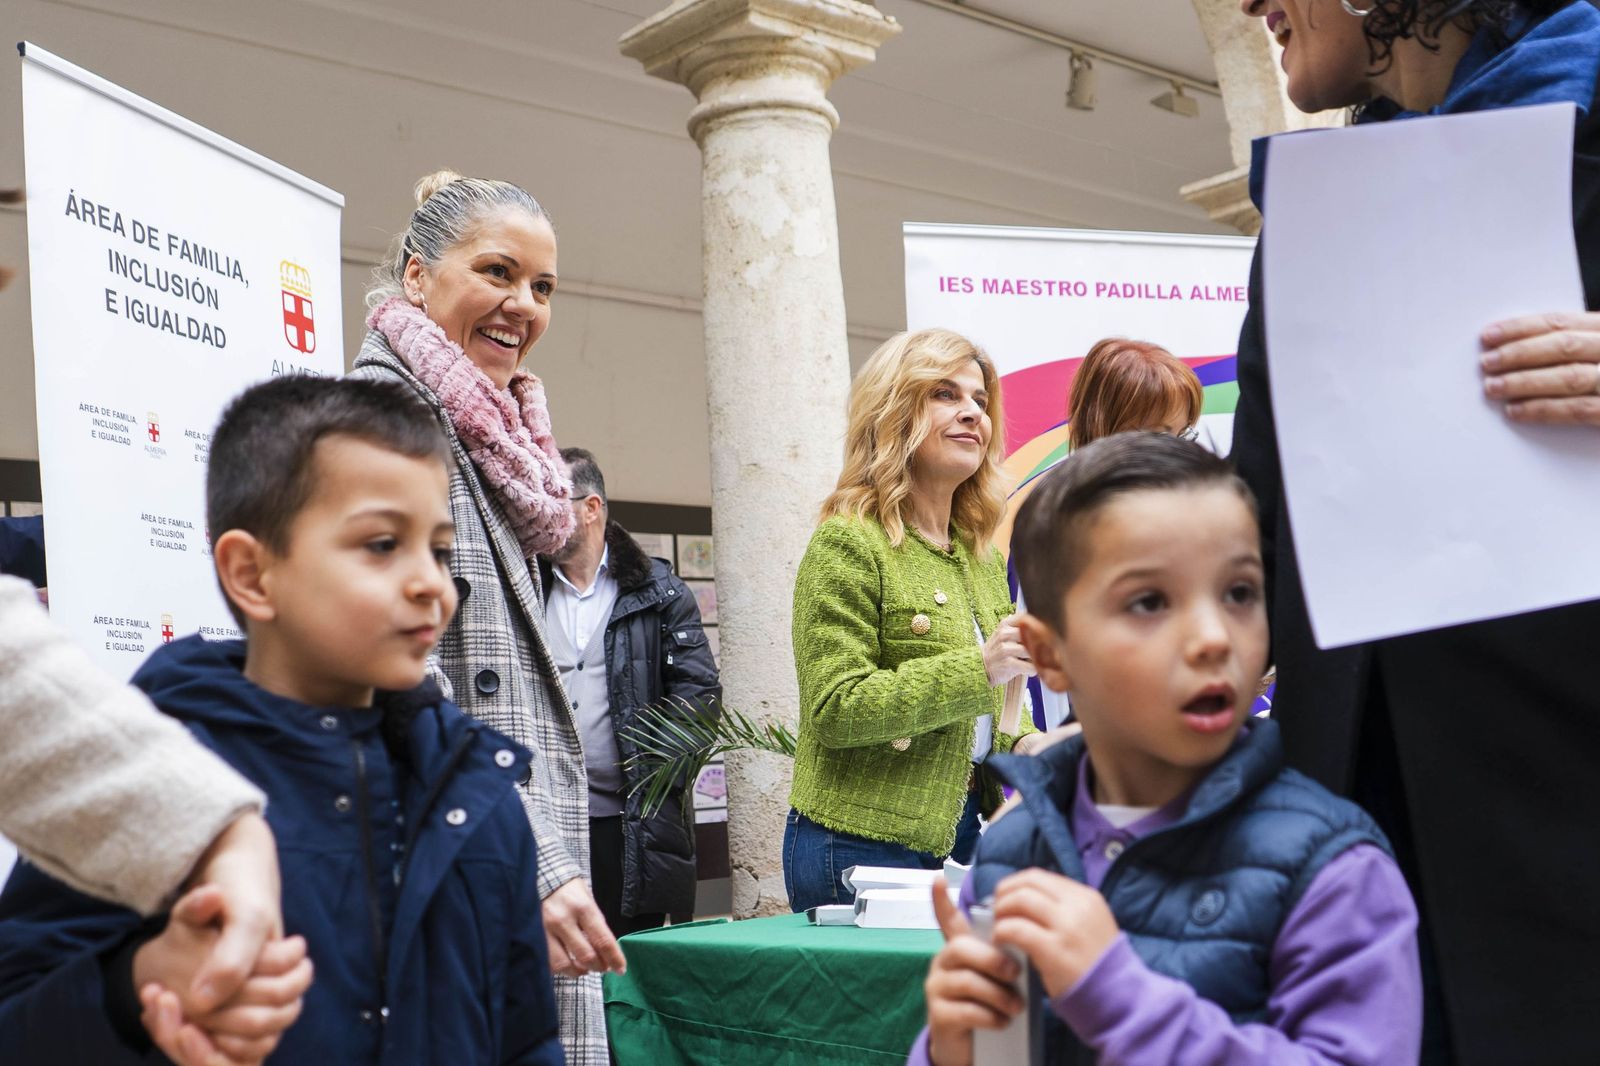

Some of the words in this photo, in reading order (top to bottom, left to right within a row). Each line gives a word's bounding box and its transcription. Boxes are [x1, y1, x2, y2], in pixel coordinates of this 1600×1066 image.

[65, 188, 126, 237] ÁREA
[132, 219, 160, 251] DE
[167, 233, 250, 288] FAMILIA,
[108, 248, 219, 310] INCLUSIÓN
[939, 275, 974, 293] IES
[982, 278, 1088, 297] MAESTRO
[1096, 282, 1182, 300] PADILLA
[1190, 285, 1249, 301] ALME
[105, 288, 119, 314] E
[125, 295, 227, 349] IGUALDAD
[101, 407, 111, 417] DE
[91, 430, 97, 438] E
[98, 431, 131, 446] IGUALDAD
[158, 516, 167, 525] DE
[150, 538, 155, 547] E
[156, 539, 187, 552] IGUALDAD
[115, 617, 125, 626] DE
[126, 618, 152, 630] FAMILIA,
[216, 627, 225, 636] DE
[105, 641, 111, 650] E
[112, 642, 145, 653] IGUALDAD
